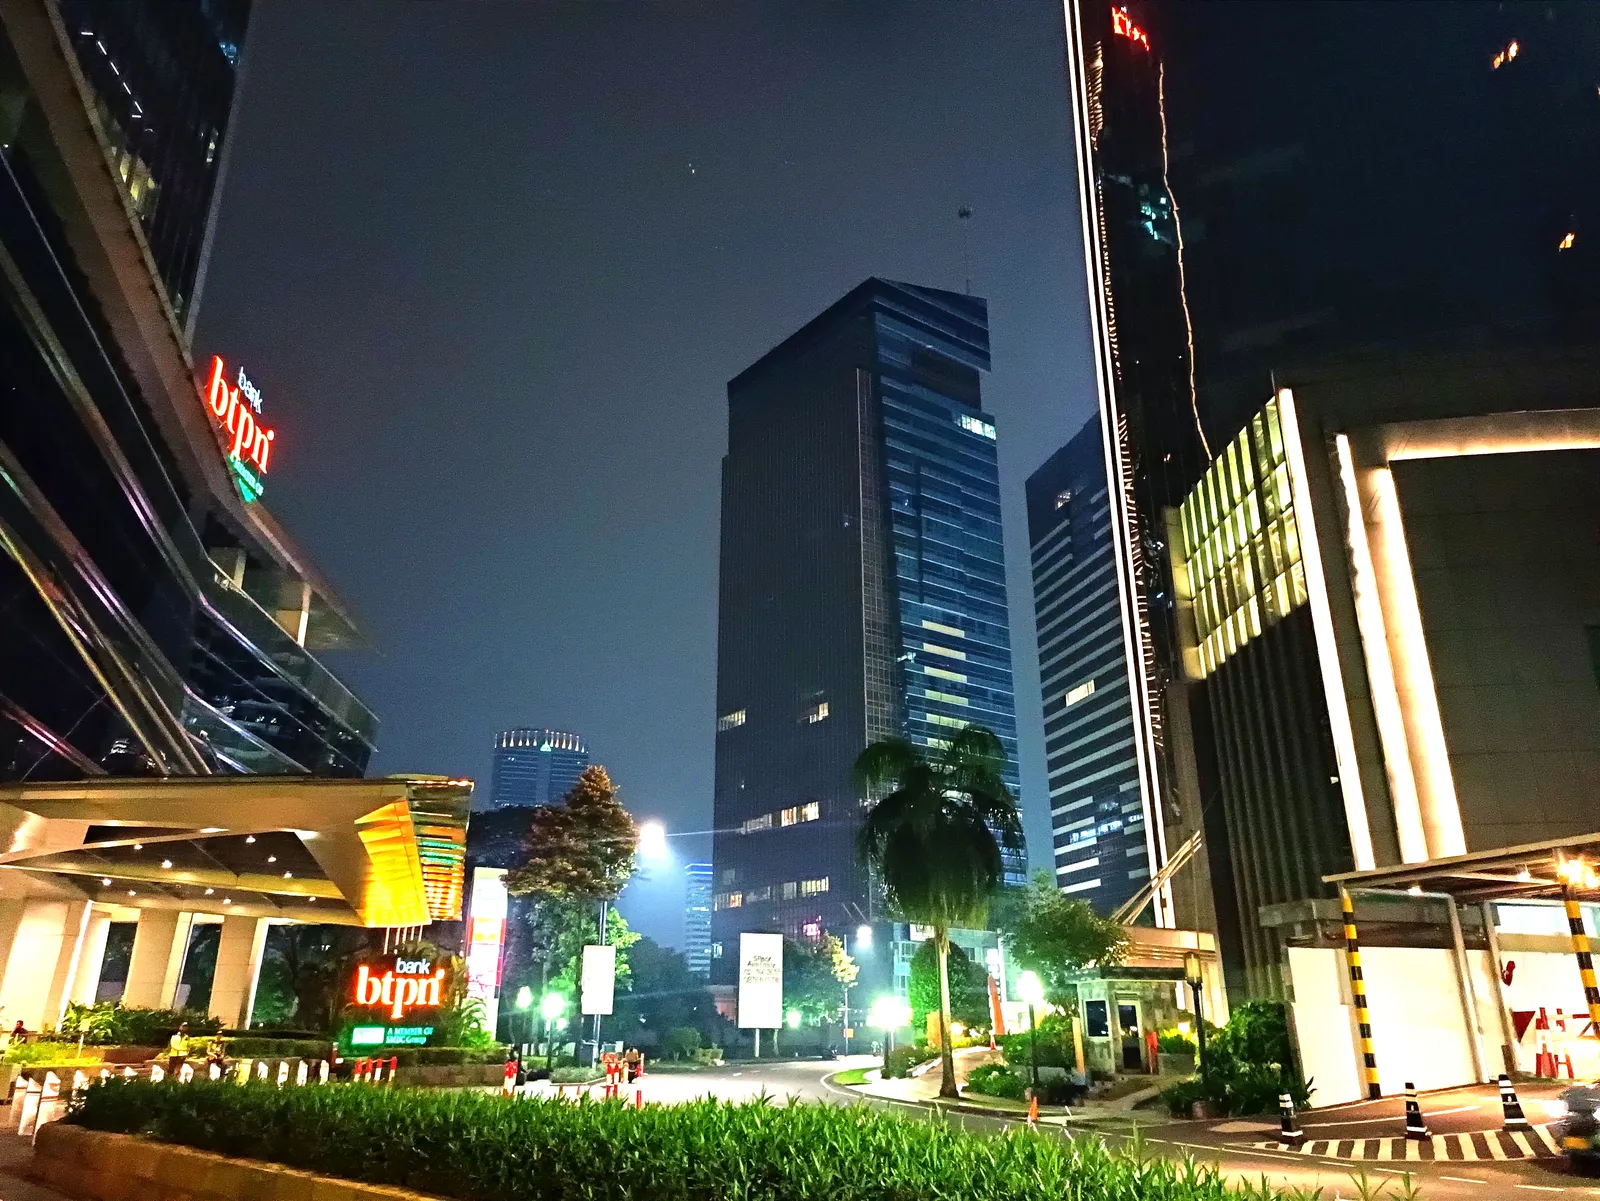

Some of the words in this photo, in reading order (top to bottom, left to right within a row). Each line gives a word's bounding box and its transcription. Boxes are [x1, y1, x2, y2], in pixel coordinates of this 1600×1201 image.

[209, 355, 274, 475] btpn
[238, 366, 263, 414] bank
[396, 957, 431, 974] bank
[356, 966, 445, 1019] btpn
